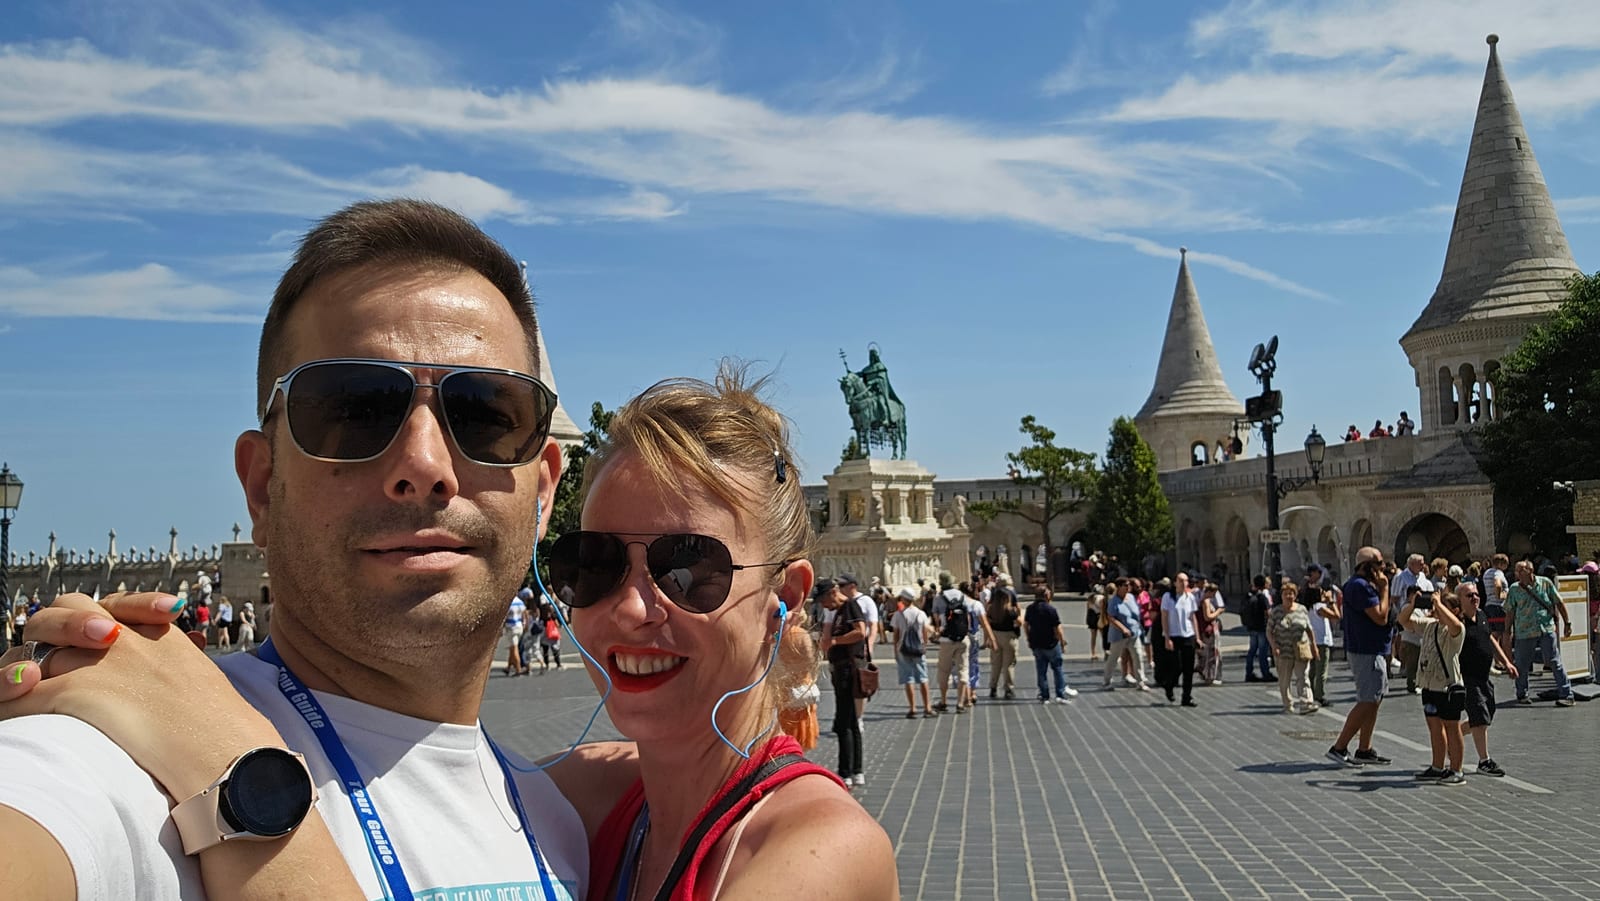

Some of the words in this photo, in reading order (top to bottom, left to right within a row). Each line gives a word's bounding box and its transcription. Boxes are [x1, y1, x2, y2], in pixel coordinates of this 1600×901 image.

[290, 692, 325, 729] Guide
[348, 781, 374, 816] Tour
[366, 819, 395, 865] Guide
